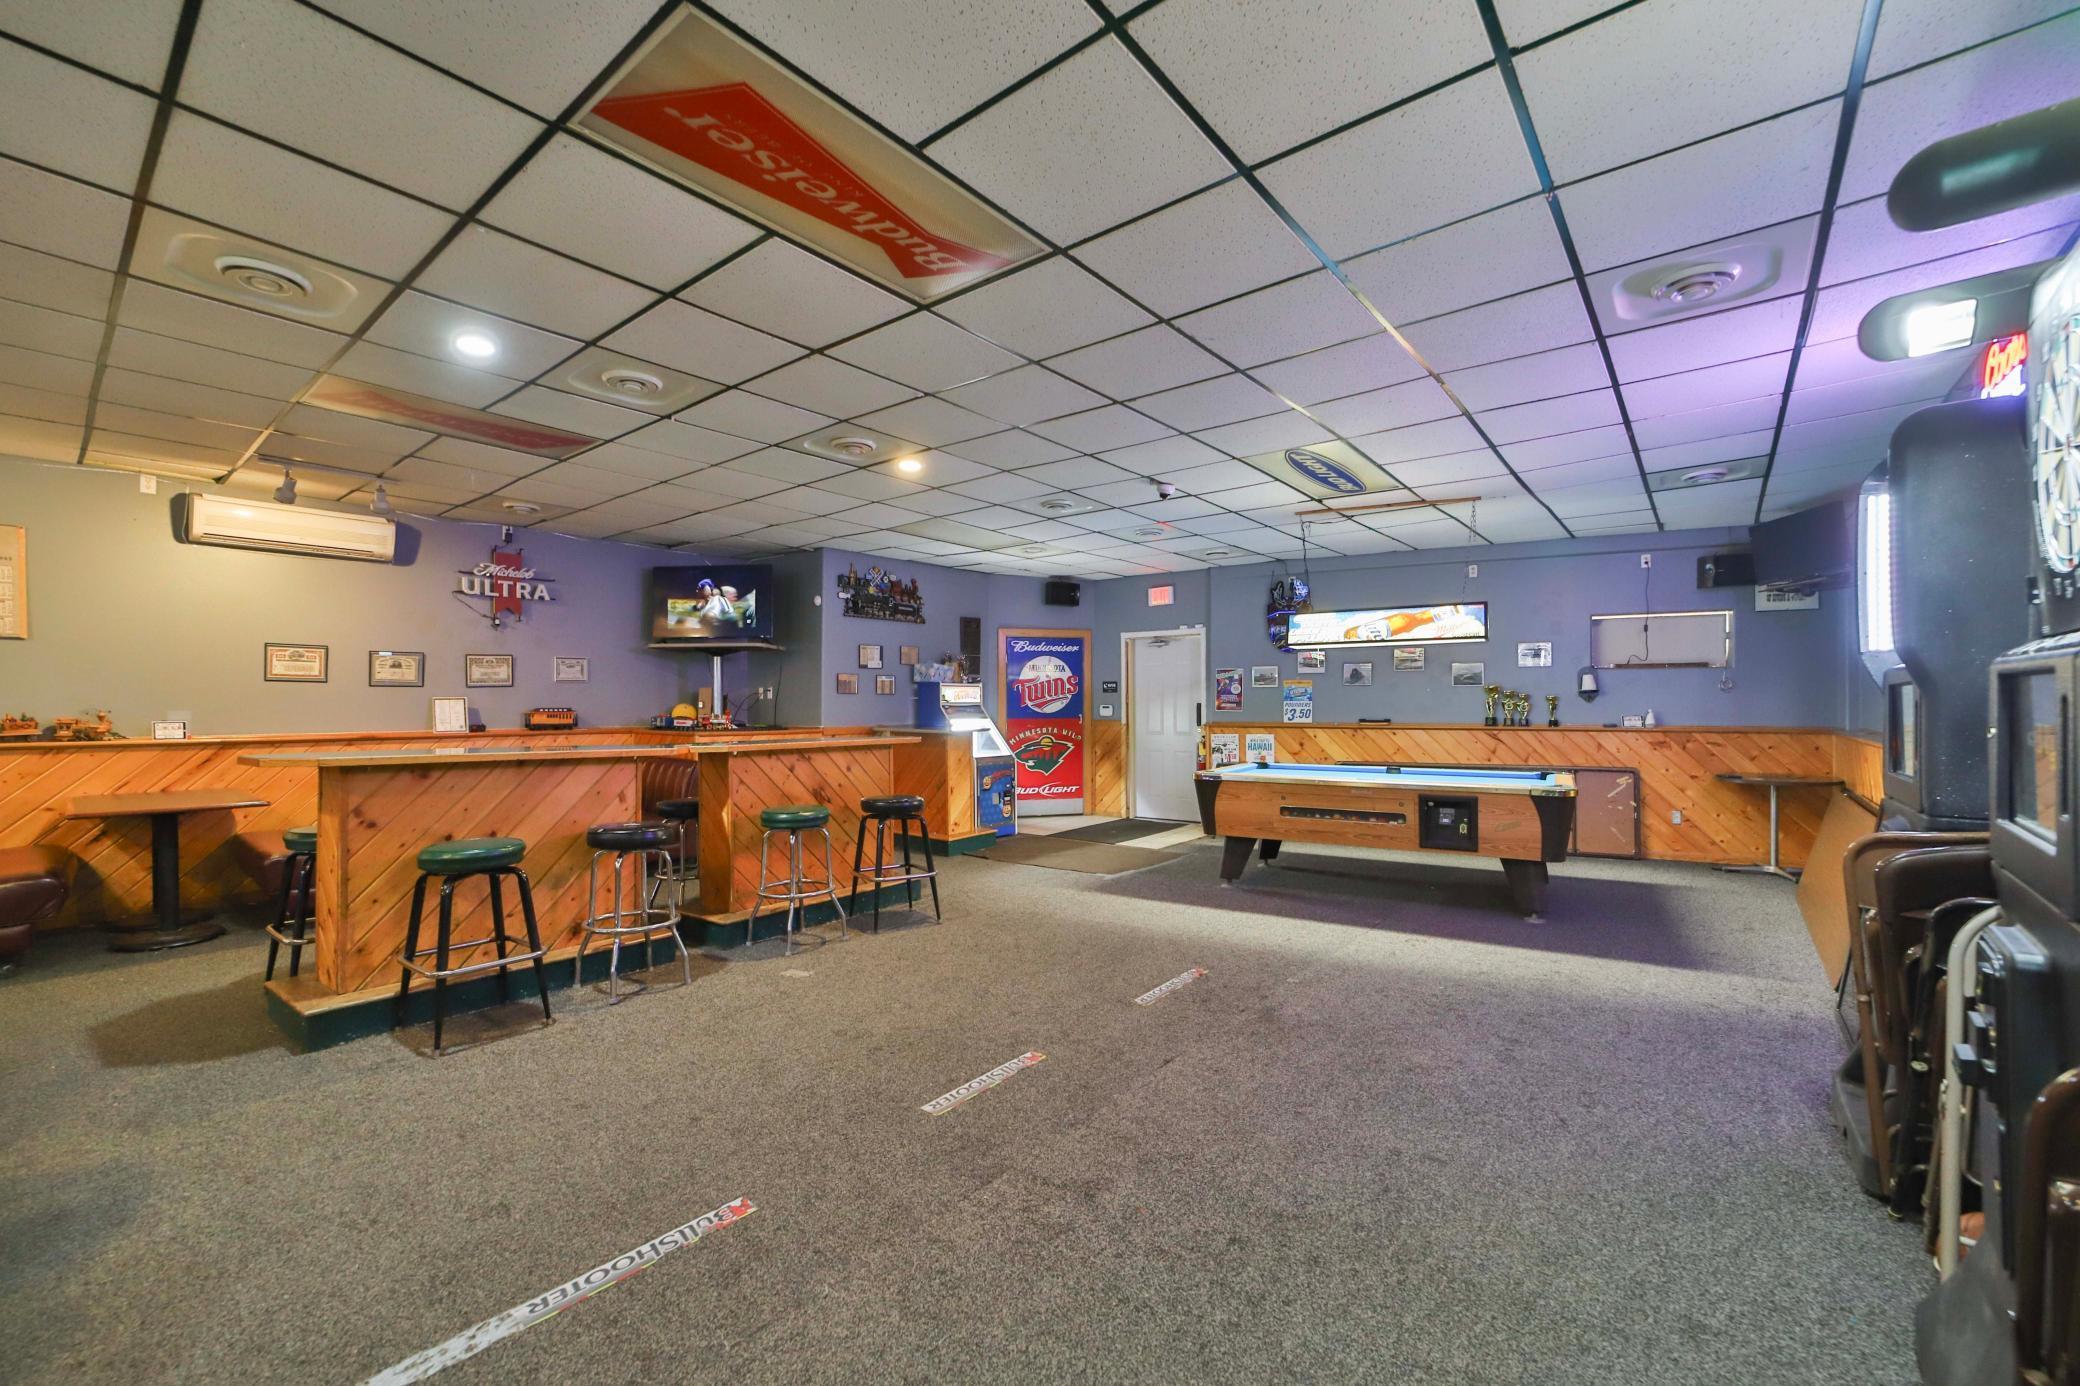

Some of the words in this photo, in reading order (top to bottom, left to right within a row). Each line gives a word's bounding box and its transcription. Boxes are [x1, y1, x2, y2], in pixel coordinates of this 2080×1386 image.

[664, 106, 967, 271] Budweiser
[473, 562, 536, 579] Michelob
[461, 576, 551, 601] ULTRA
[1010, 640, 1080, 653] Budweiser
[1011, 675, 1079, 708] Twins
[1284, 708, 1312, 722] $3.50
[1009, 727, 1058, 745] MINNESOTA
[1062, 729, 1081, 741] WILD
[1247, 742, 1273, 752] HAWAII
[1043, 785, 1080, 794] LIGHT
